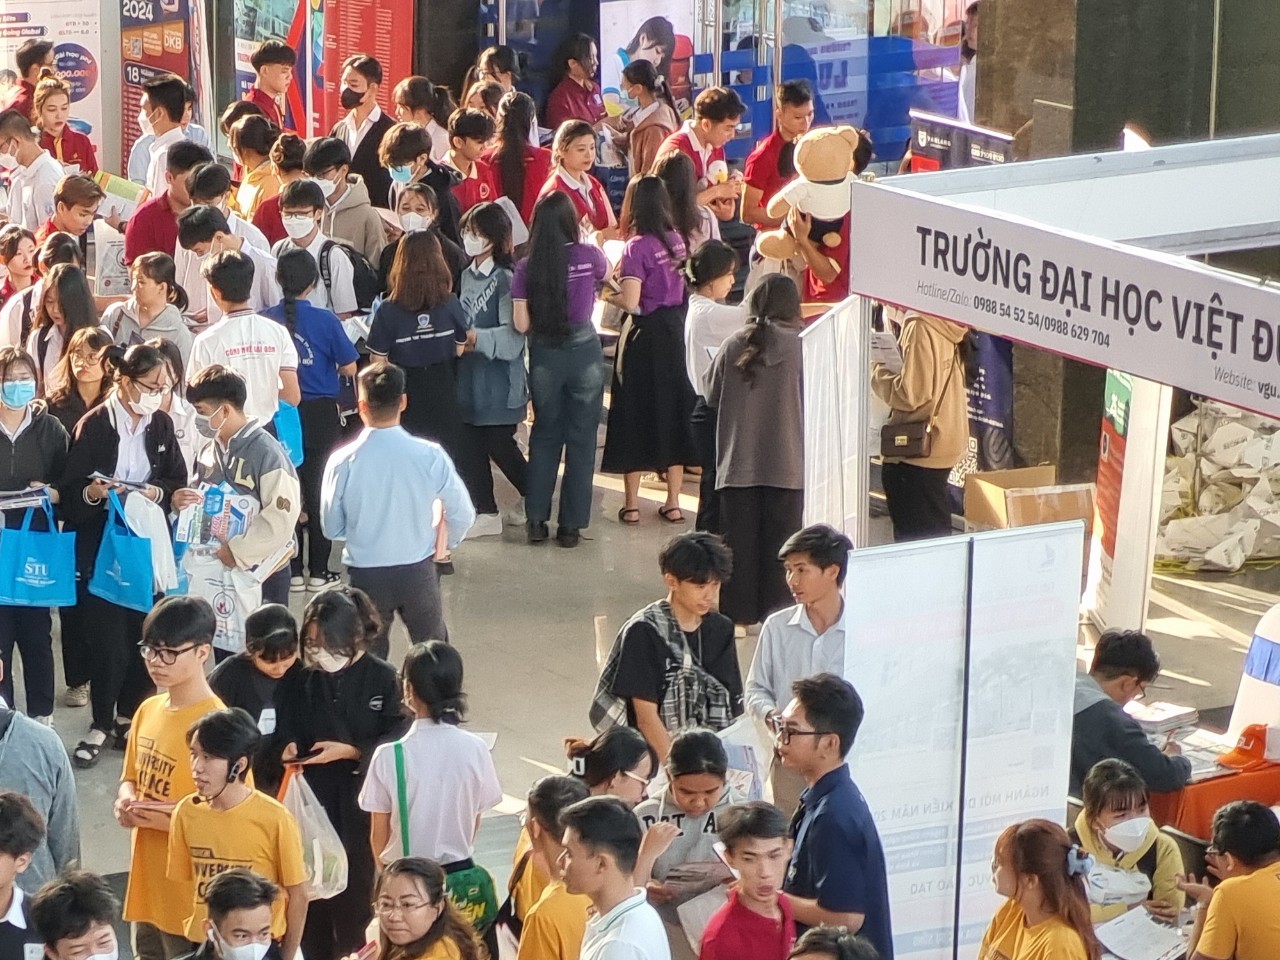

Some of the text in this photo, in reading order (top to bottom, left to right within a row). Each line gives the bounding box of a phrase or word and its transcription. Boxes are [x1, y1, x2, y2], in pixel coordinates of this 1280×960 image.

[123, 0, 153, 21] 2024
[127, 66, 140, 82] 18
[916, 226, 1280, 367] TRƯỜNG ĐẠI HỌC VIỆT Đ
[973, 296, 997, 314] 0988
[999, 303, 1011, 319] 54
[1014, 307, 1025, 323] 52
[1028, 311, 1069, 336] 54/0988
[1070, 324, 1089, 341] 629
[1091, 331, 1111, 348] 704
[1214, 366, 1256, 391] Website:
[234, 458, 255, 490] L
